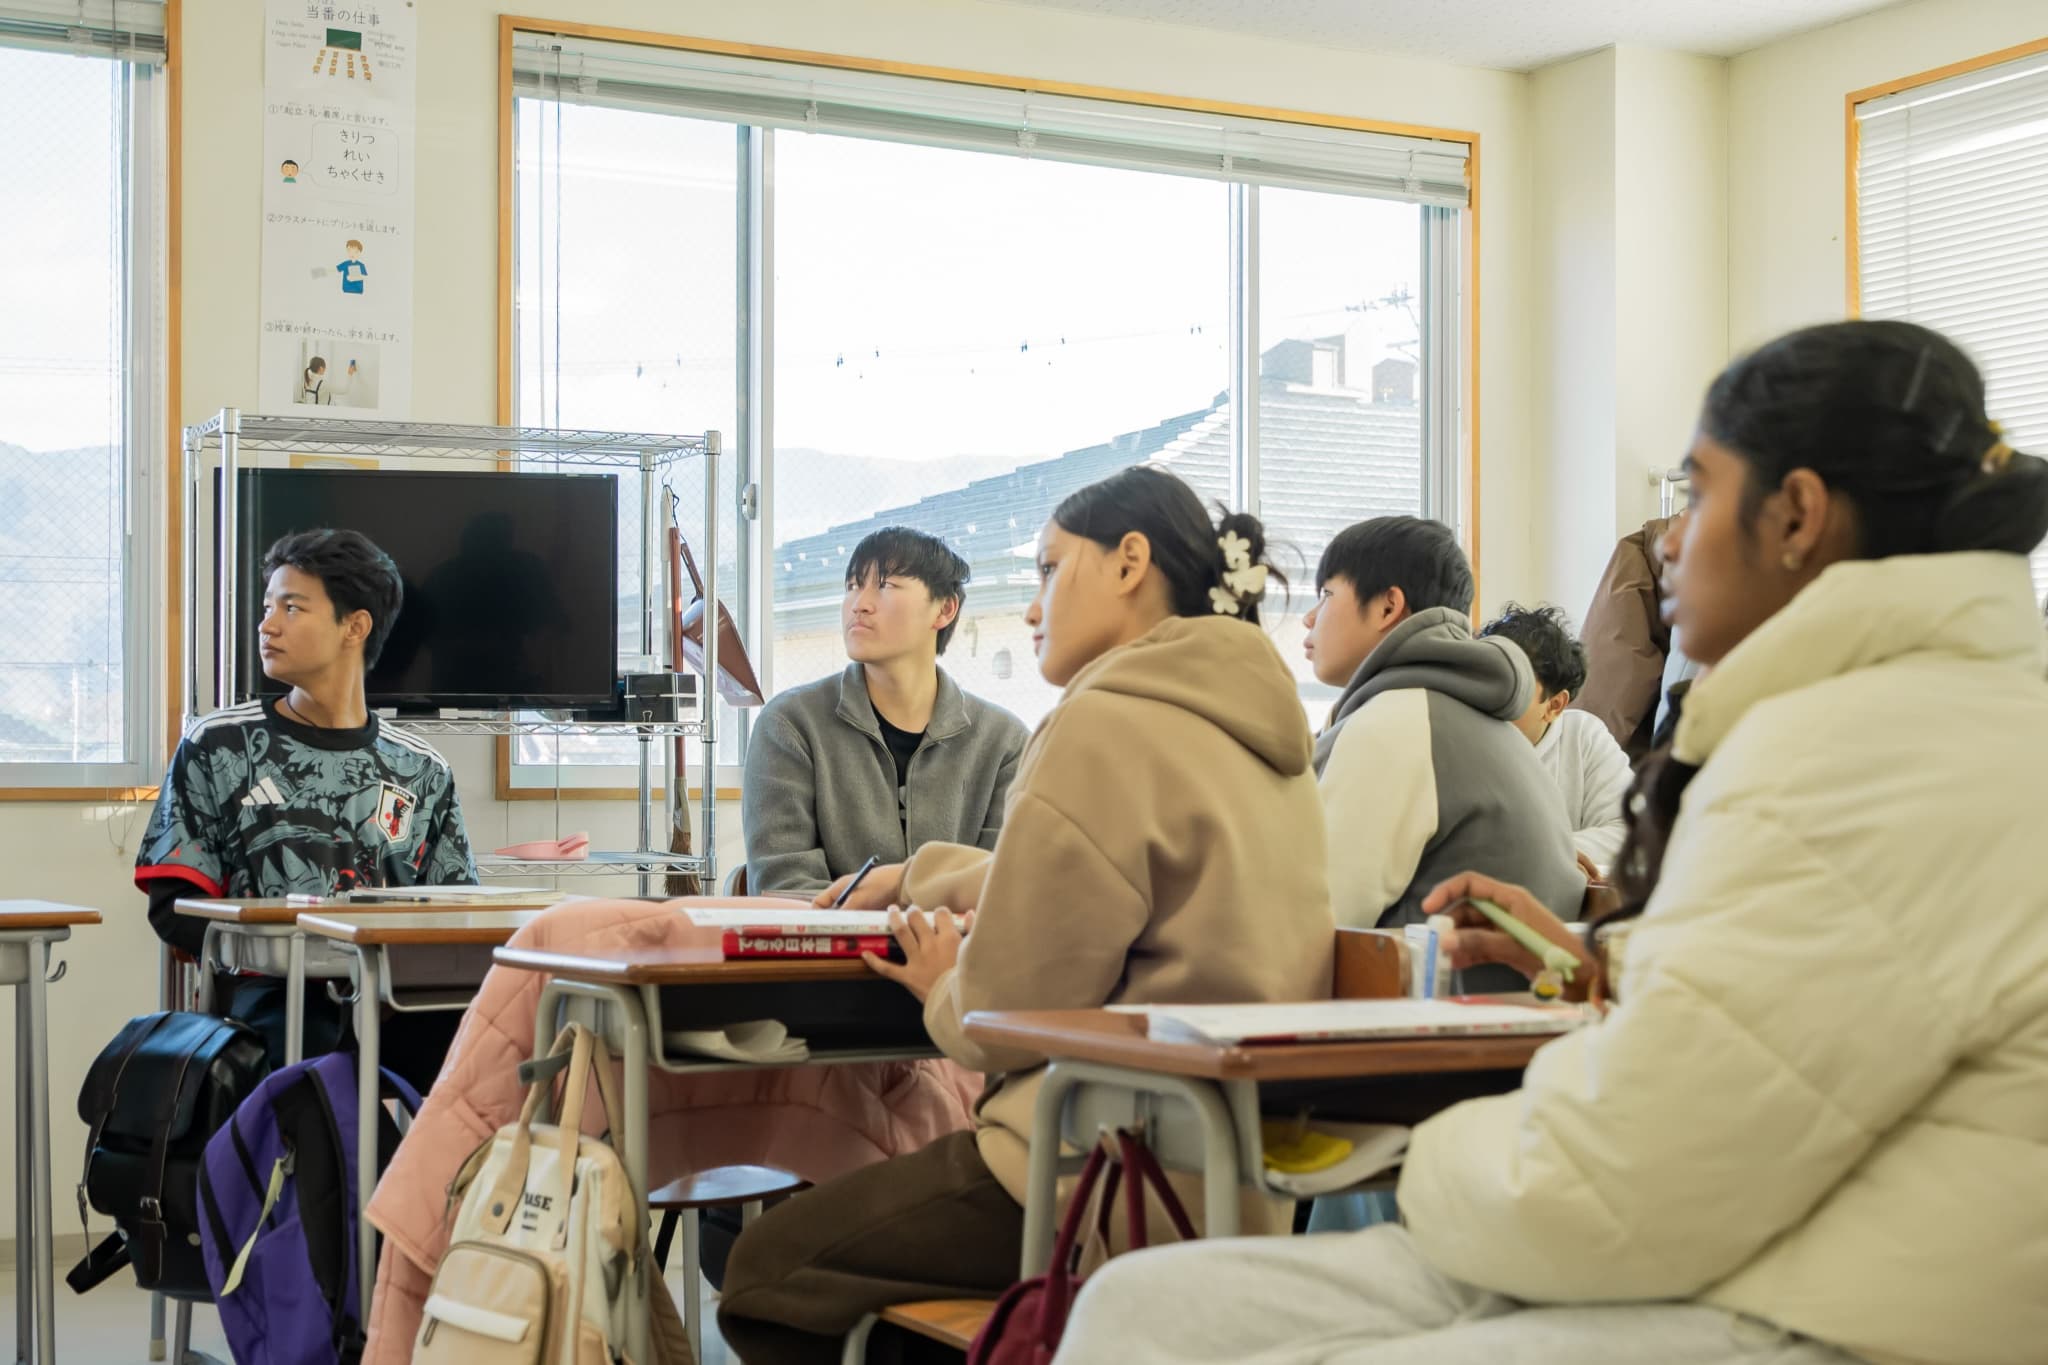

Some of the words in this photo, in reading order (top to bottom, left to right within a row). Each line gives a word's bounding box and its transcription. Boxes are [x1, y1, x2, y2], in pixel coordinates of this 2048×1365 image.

[306, 5, 380, 27] 当番の仕事
[339, 129, 376, 145] きりつ
[343, 149, 370, 162] れい
[327, 165, 385, 184] ちゃくせき
